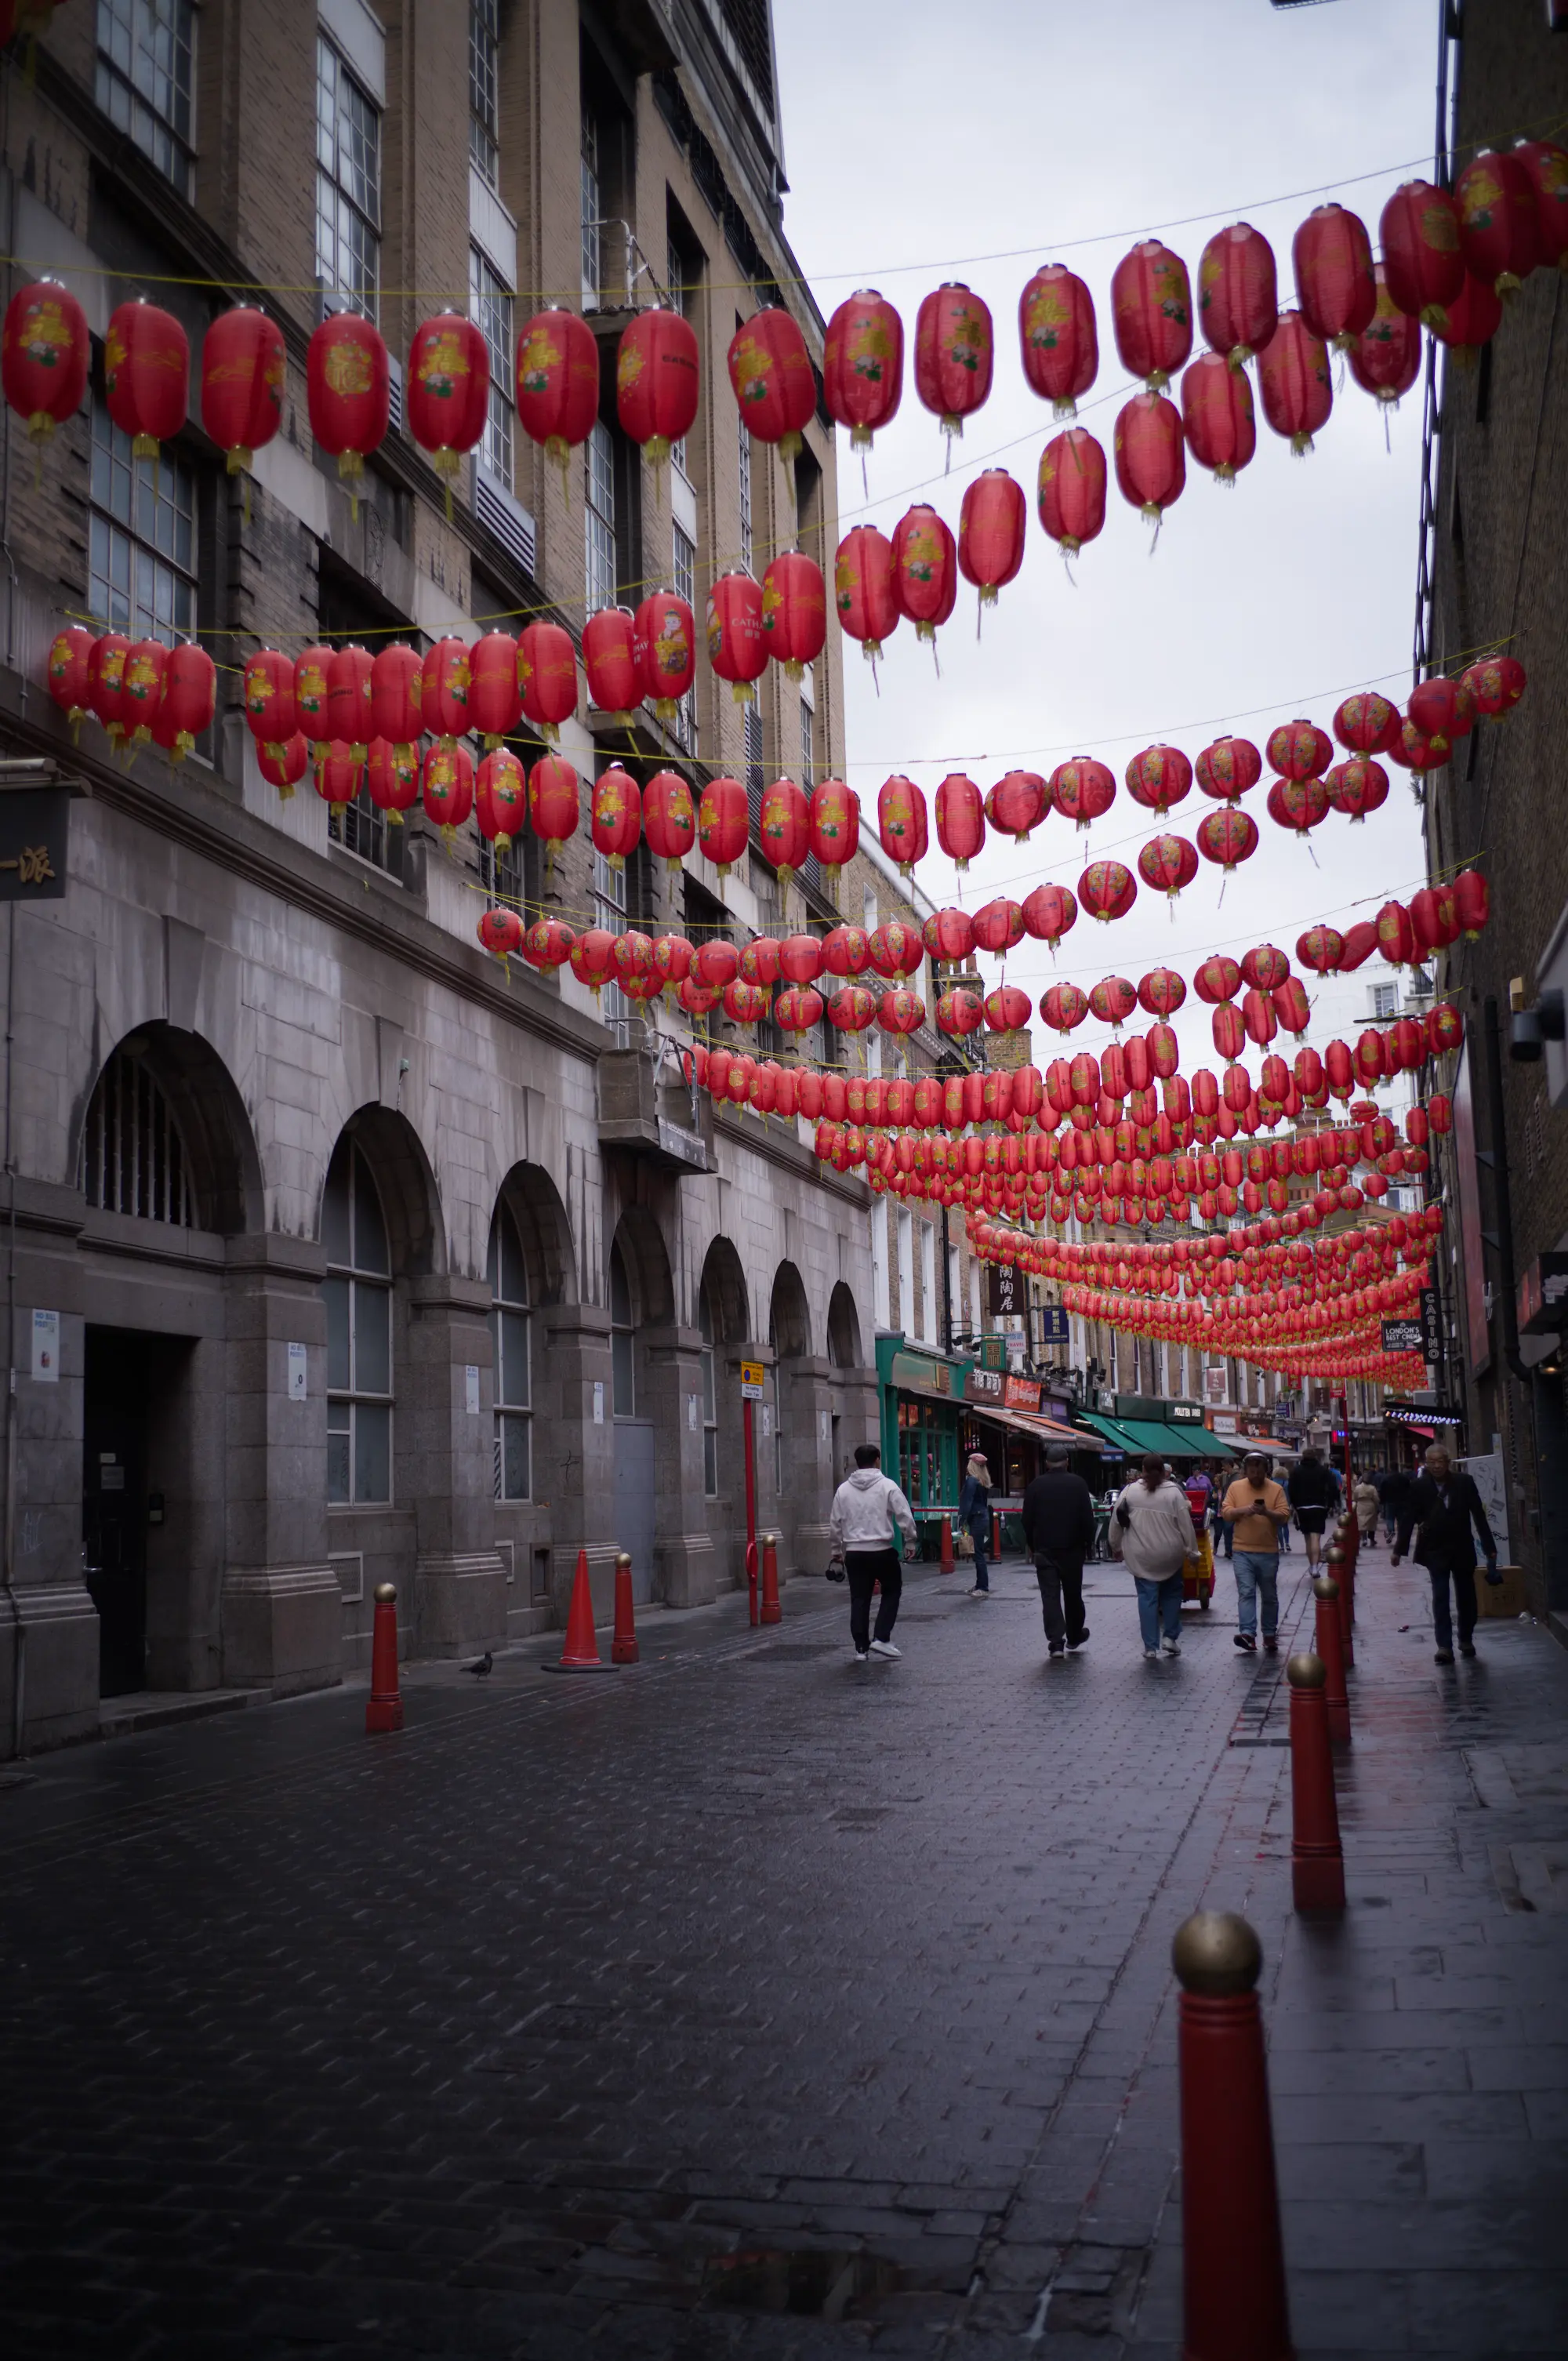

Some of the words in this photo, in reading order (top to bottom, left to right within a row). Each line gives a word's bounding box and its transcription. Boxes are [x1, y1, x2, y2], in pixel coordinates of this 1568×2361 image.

[731, 617, 764, 630] CATHA
[1385, 1326, 1420, 1335] LONDON'S
[1425, 1293, 1439, 1360] CASINO
